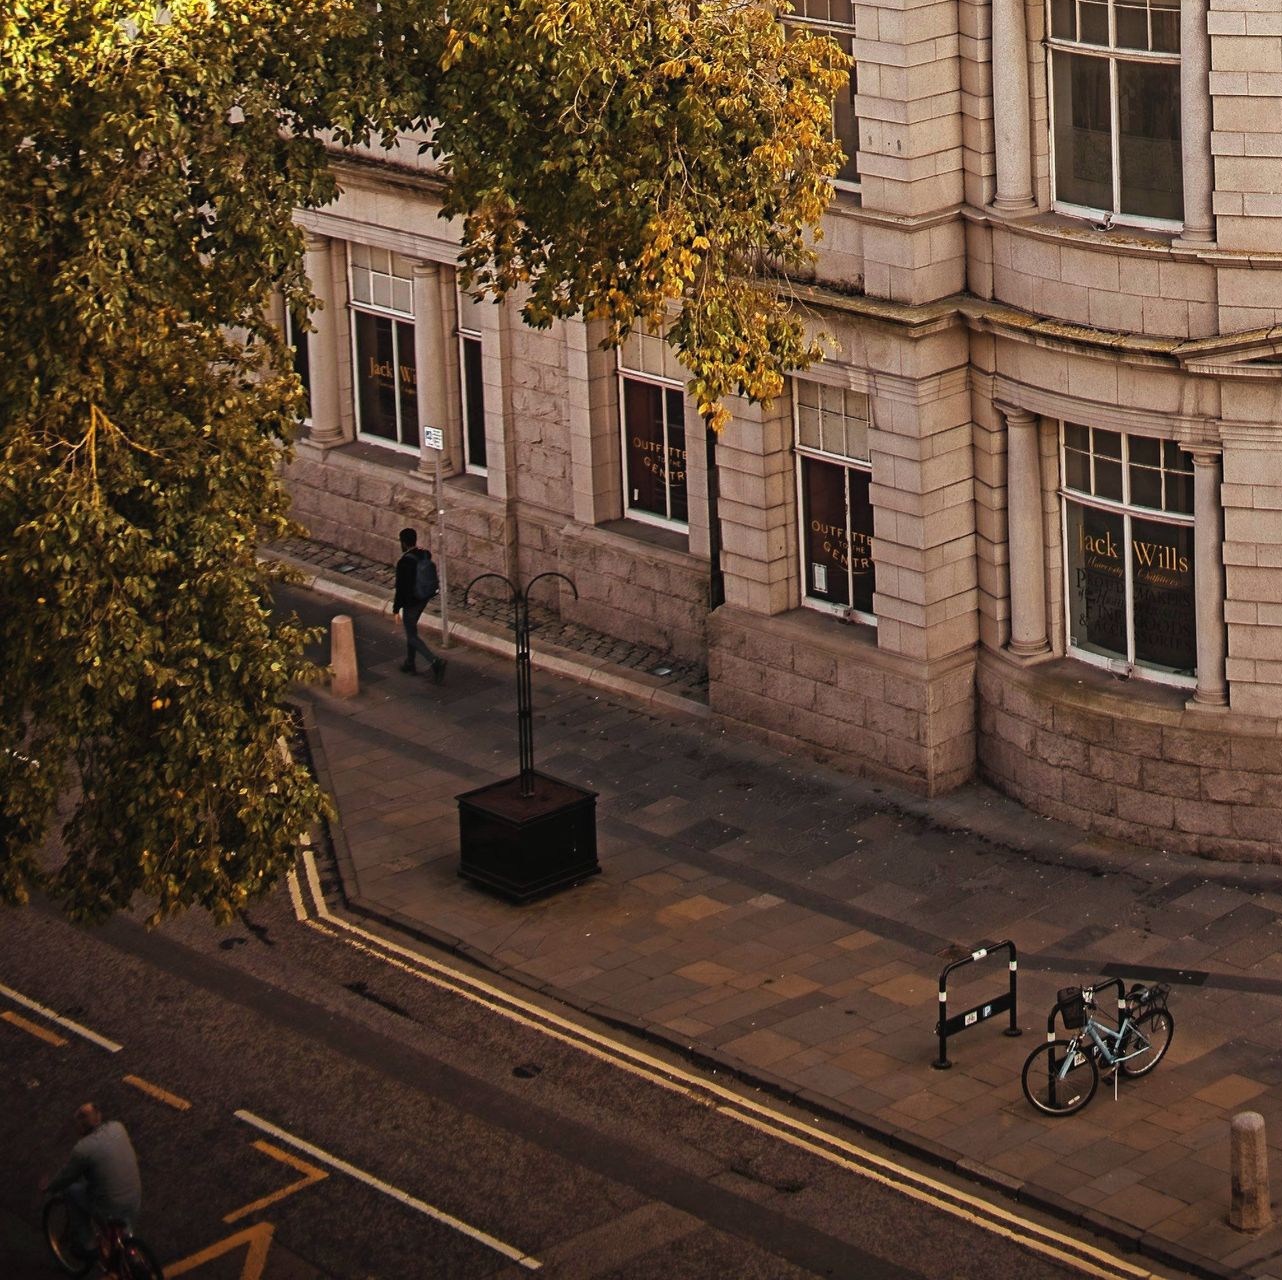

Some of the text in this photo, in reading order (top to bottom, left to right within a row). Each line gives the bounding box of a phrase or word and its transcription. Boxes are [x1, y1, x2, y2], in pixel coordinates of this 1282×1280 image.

[368, 356, 394, 379] Jack
[1078, 523, 1189, 573] Jack Wills
